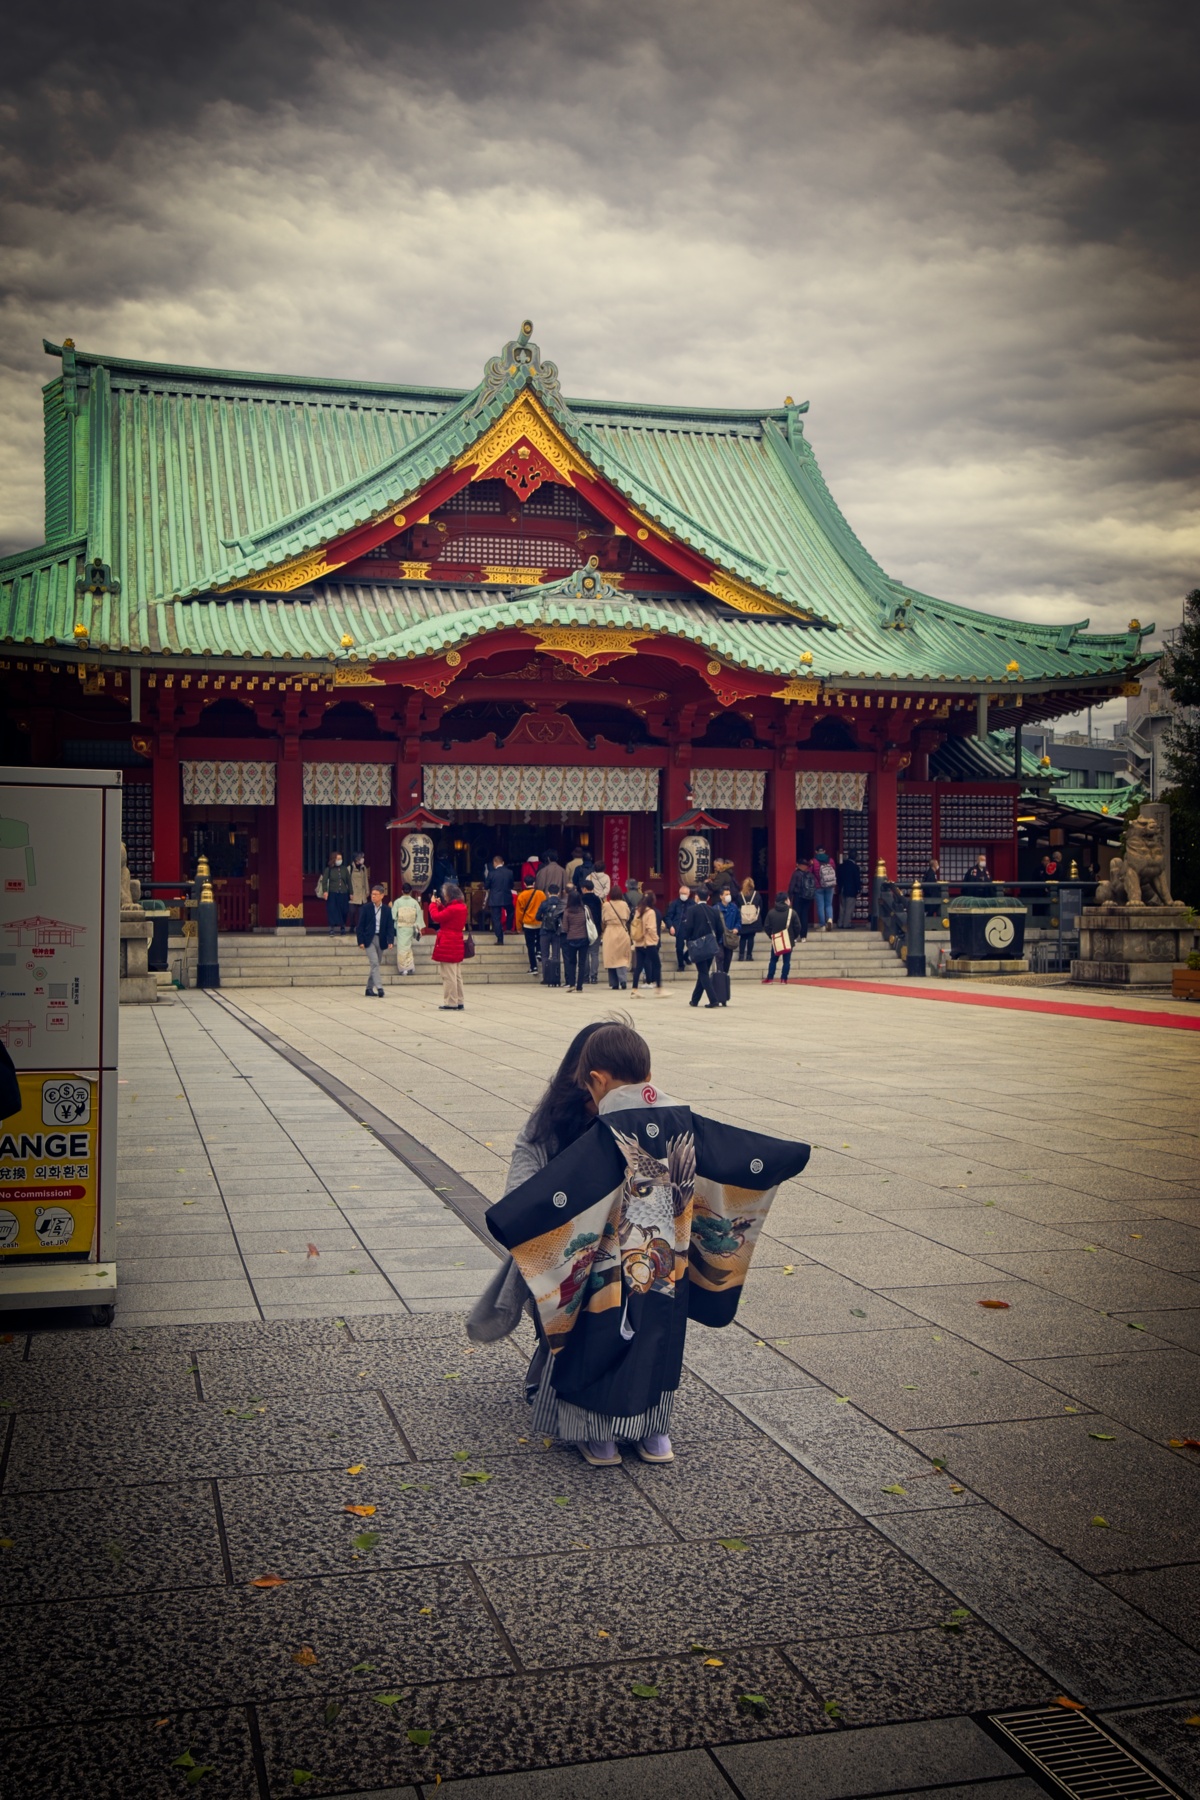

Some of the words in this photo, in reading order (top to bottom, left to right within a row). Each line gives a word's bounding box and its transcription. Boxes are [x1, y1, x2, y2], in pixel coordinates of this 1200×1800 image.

[412, 845, 429, 883] 神田明神
[0, 1134, 88, 1158] ANGE
[35, 1164, 88, 1179] 외화환전
[14, 1189, 71, 1198] Commission!
[53, 1219, 65, 1235] JPY
